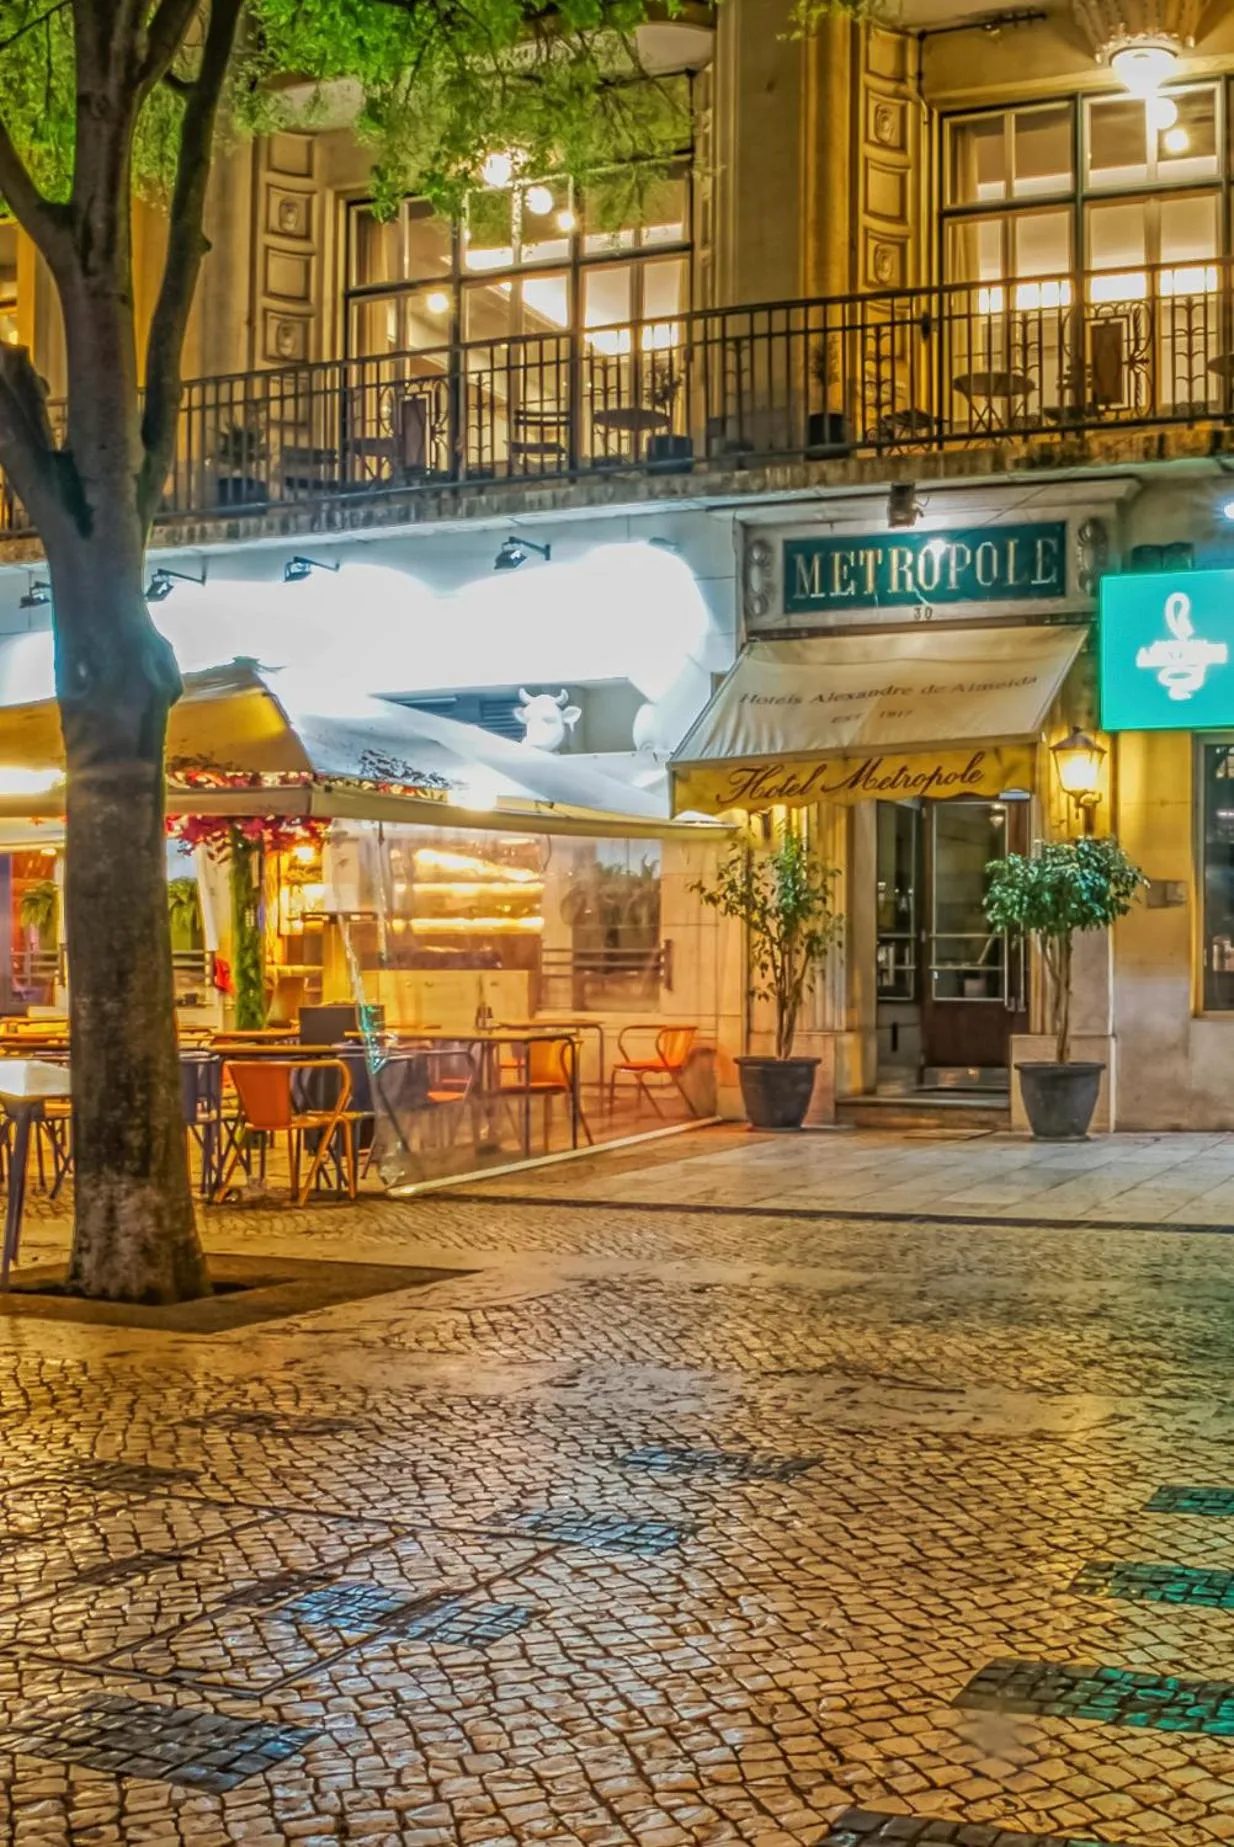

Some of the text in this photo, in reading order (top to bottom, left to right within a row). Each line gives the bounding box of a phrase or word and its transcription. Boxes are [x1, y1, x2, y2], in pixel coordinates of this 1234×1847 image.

[792, 539, 1058, 599] METROPOLE
[914, 606, 933, 621] 30
[716, 751, 986, 804] Hotel Metropole
